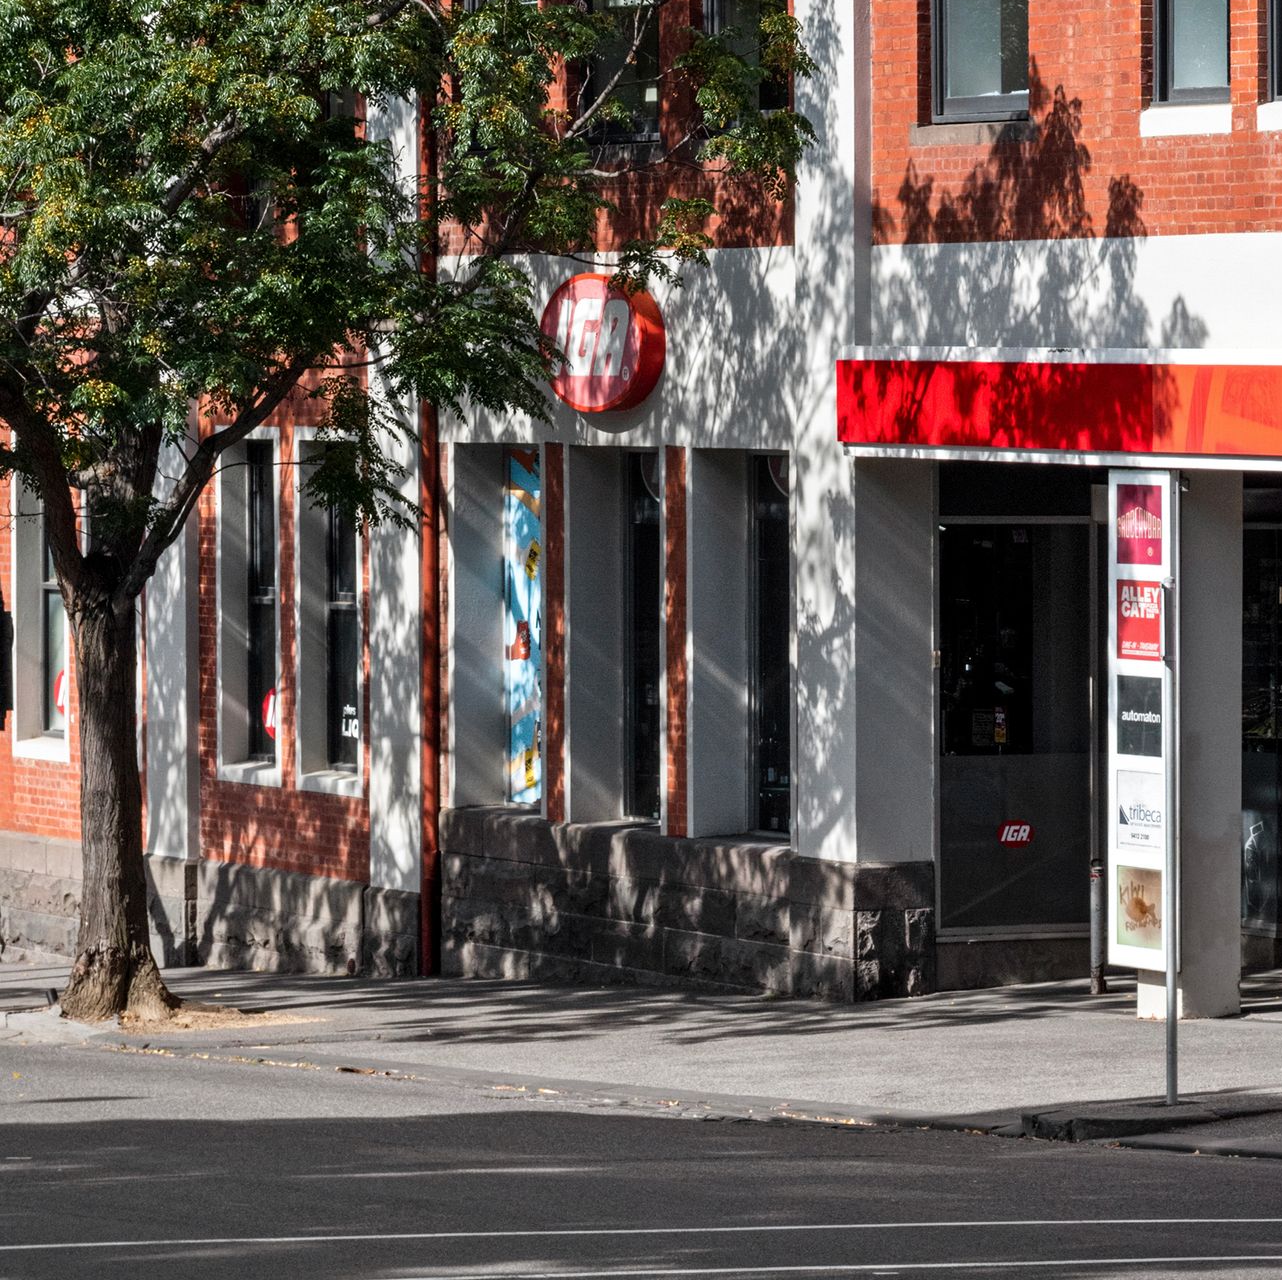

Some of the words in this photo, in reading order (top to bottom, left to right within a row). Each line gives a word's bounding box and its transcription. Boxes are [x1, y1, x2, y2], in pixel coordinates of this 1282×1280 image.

[553, 298, 630, 377] IGA
[1121, 586, 1160, 603] ALLEY
[1121, 602, 1147, 618] CAT
[1121, 709, 1161, 723] automaton
[1129, 803, 1162, 823] tribeca
[1001, 825, 1030, 842] IGA
